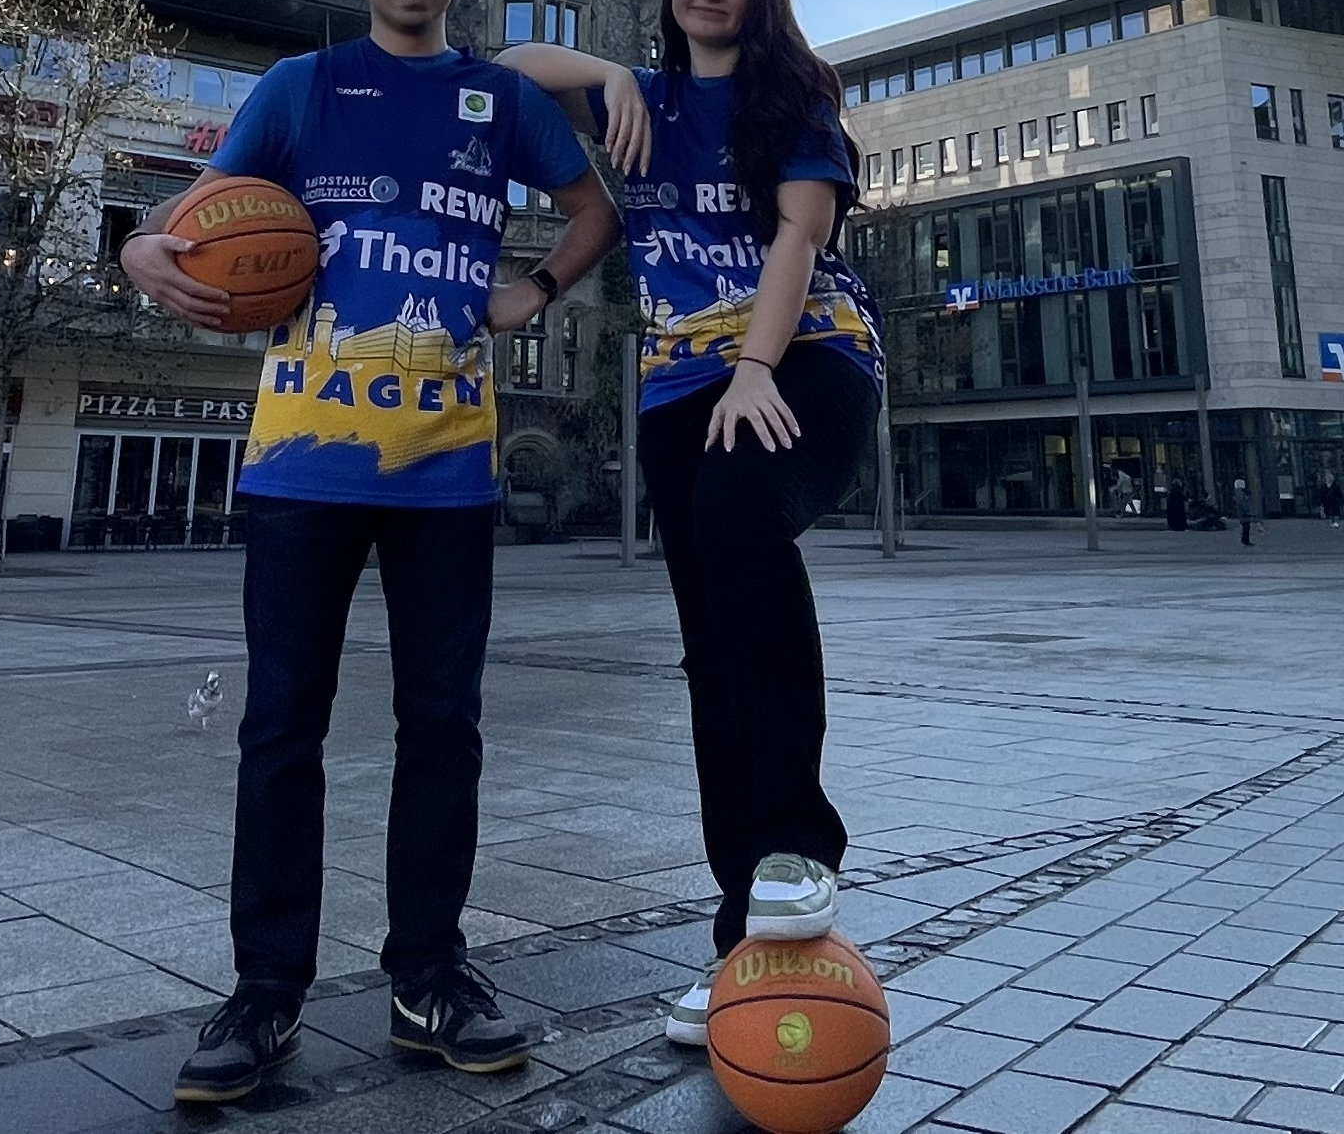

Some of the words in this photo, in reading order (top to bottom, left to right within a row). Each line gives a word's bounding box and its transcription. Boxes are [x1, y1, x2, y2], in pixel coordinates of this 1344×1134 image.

[197, 195, 300, 229] Wilson
[353, 230, 490, 288] Thalia
[1084, 266, 1136, 289] Bank
[273, 360, 484, 412] HAGEN
[78, 395, 156, 415] PIZZA
[174, 398, 185, 417] E
[202, 400, 248, 419] PAS
[734, 948, 856, 989] Wilson
